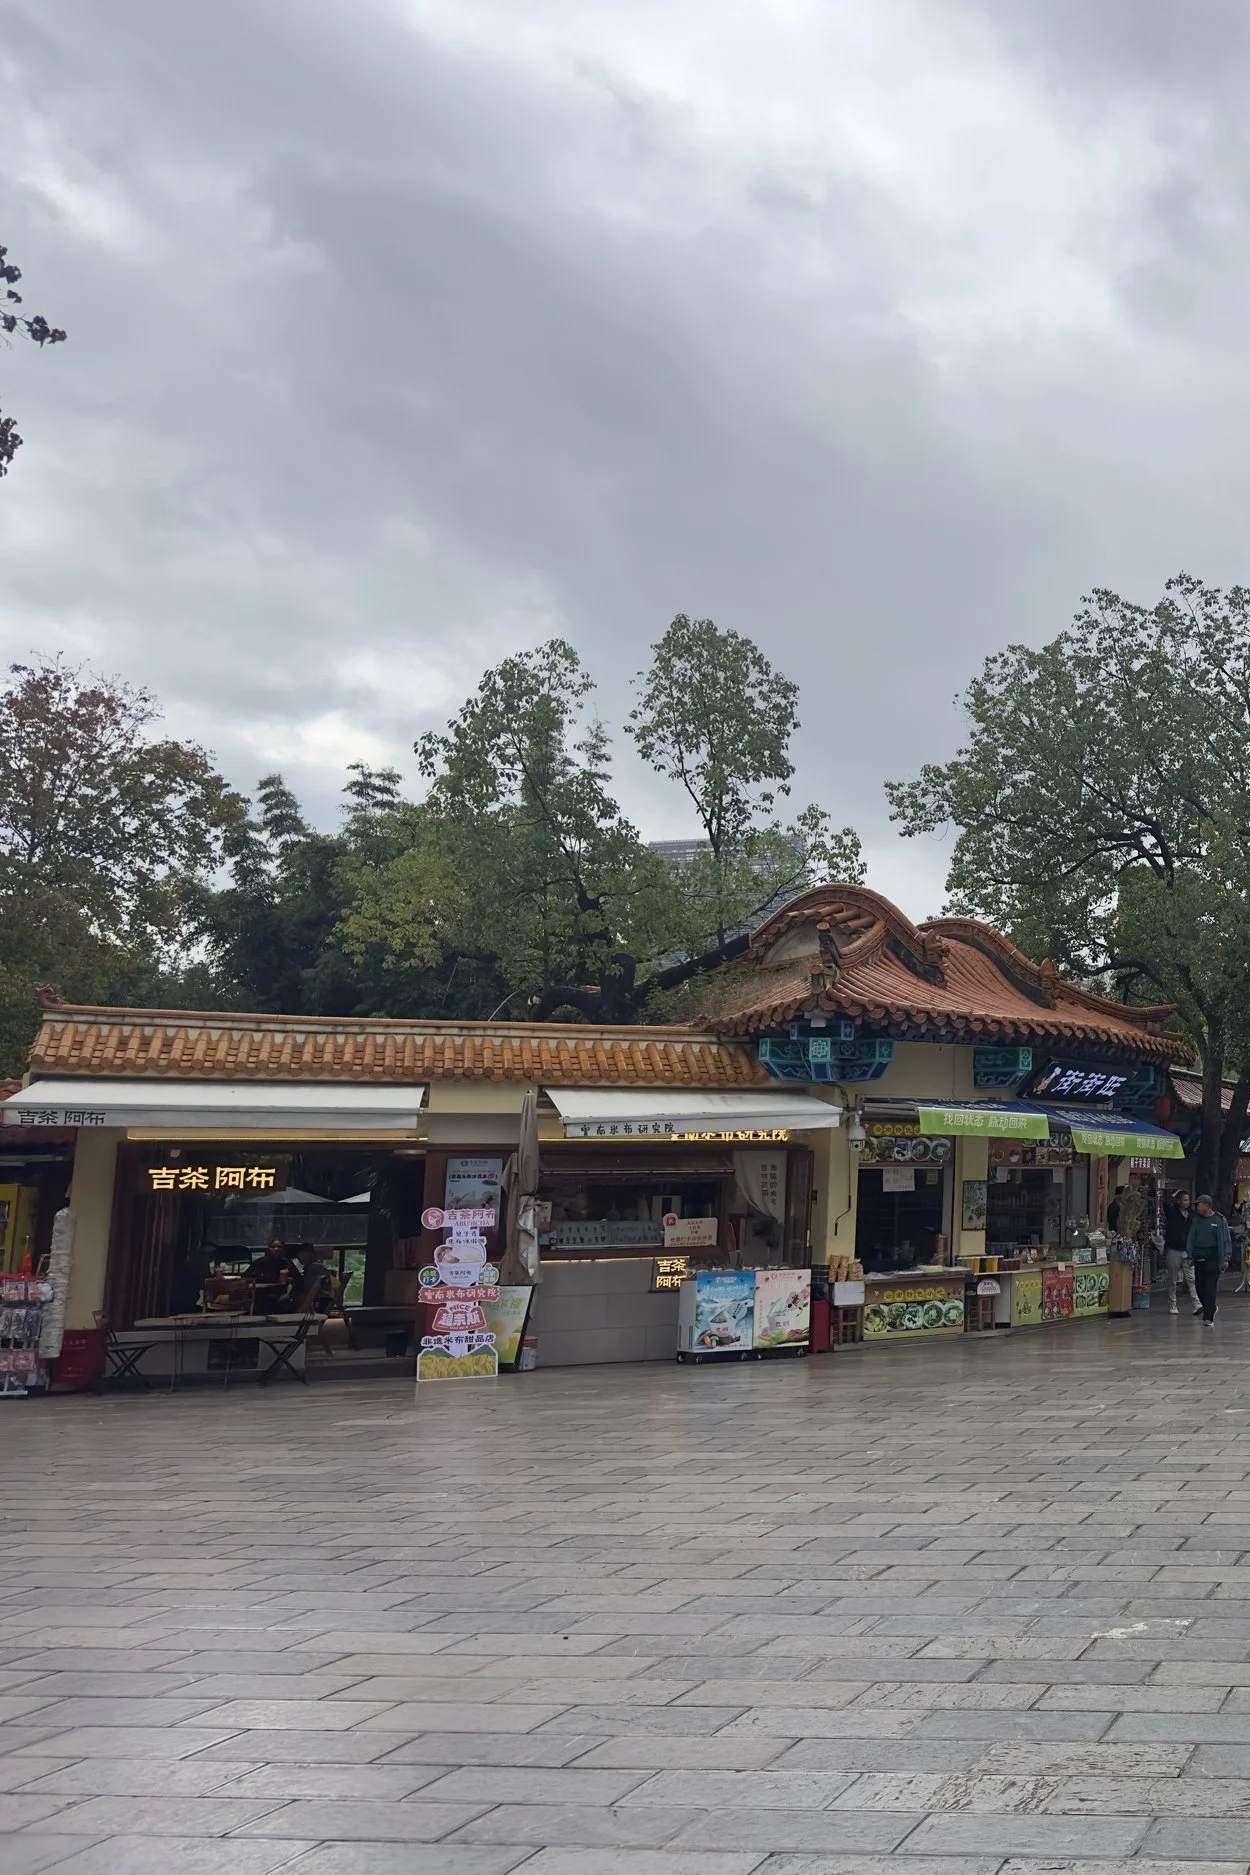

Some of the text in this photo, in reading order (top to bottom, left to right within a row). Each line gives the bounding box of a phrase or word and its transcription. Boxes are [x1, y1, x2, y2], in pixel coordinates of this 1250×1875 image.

[1051, 1068, 1127, 1097] 街街旺
[943, 1113, 1027, 1130] 找回状态 脉动回来
[1081, 1133, 1103, 1145] 找回状态
[447, 1209, 496, 1221] 吉茶阿布
[657, 1258, 687, 1273] 吉茶
[449, 1304, 472, 1312] NICE
